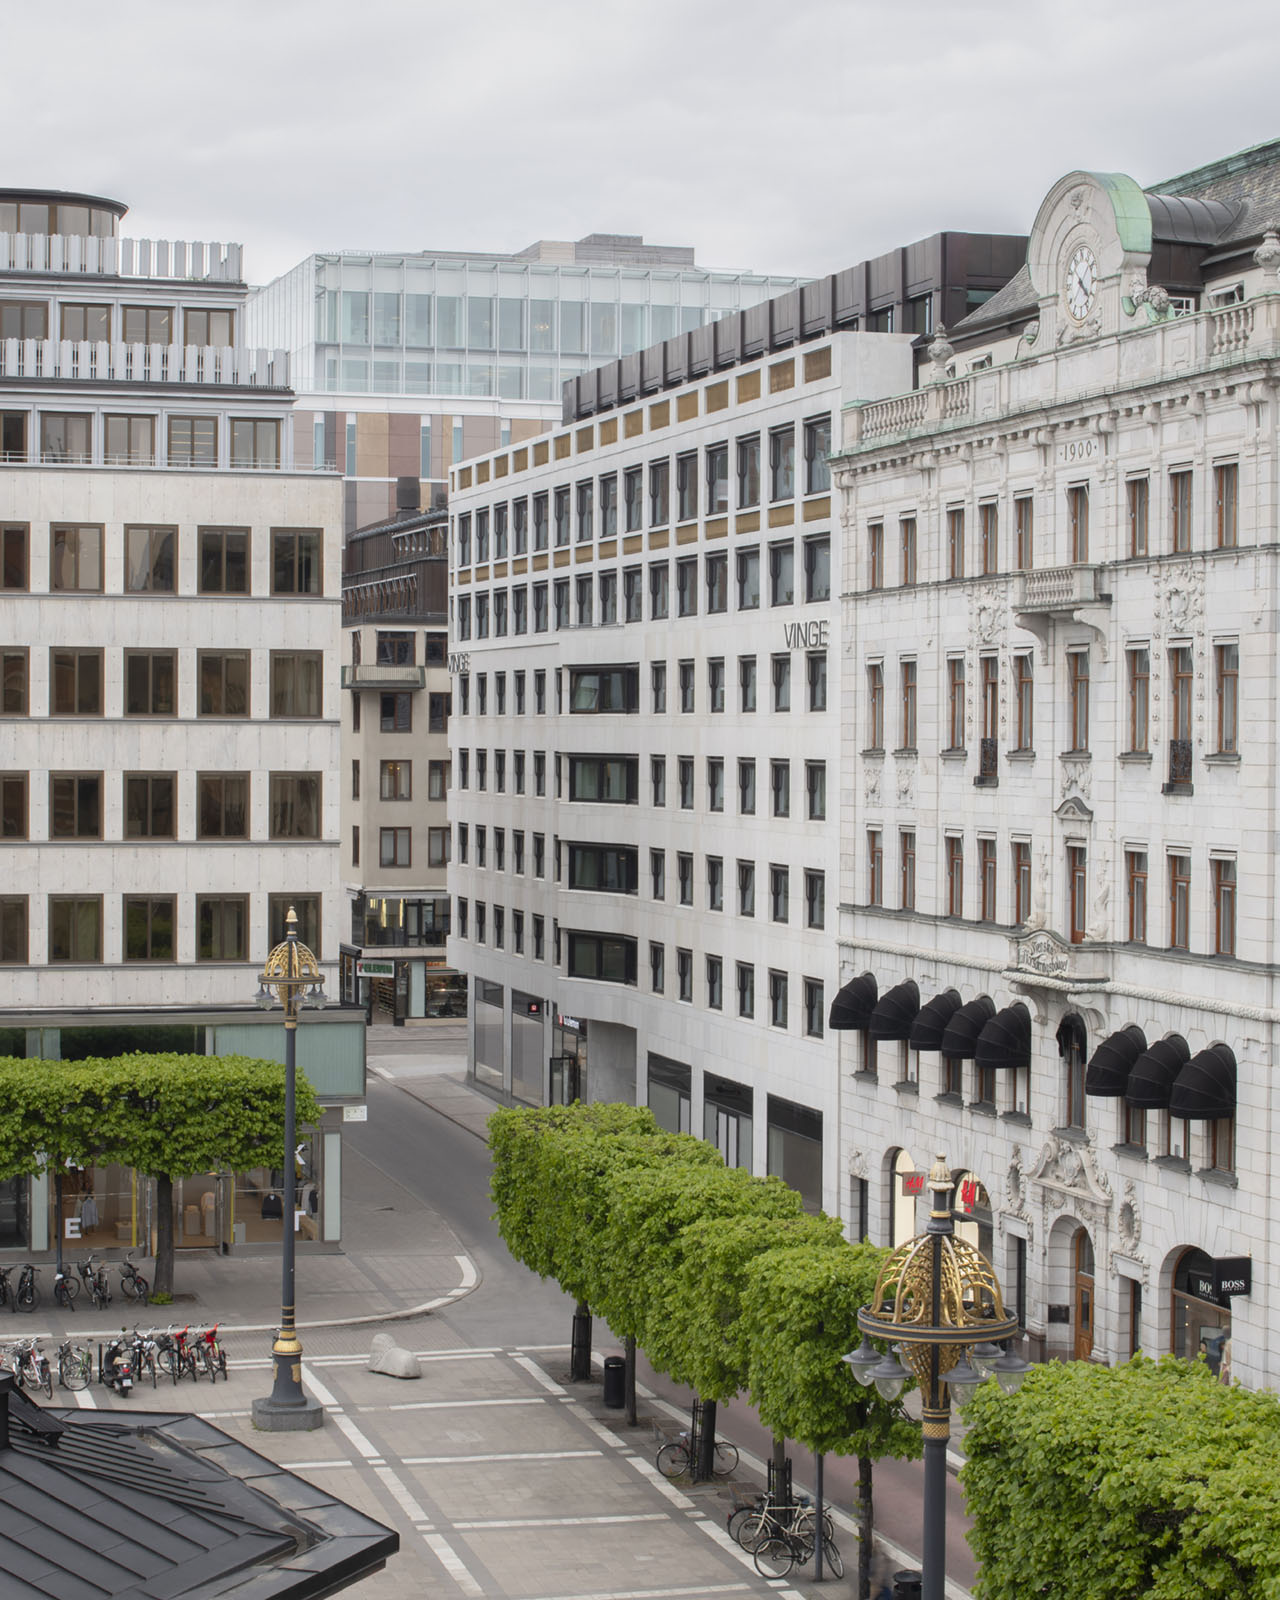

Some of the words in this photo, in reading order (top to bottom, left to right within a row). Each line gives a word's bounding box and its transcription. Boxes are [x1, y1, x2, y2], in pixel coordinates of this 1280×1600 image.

[783, 620, 829, 648] VINGE
[64, 1217, 82, 1239] E
[1221, 1279, 1246, 1289] BOSS
